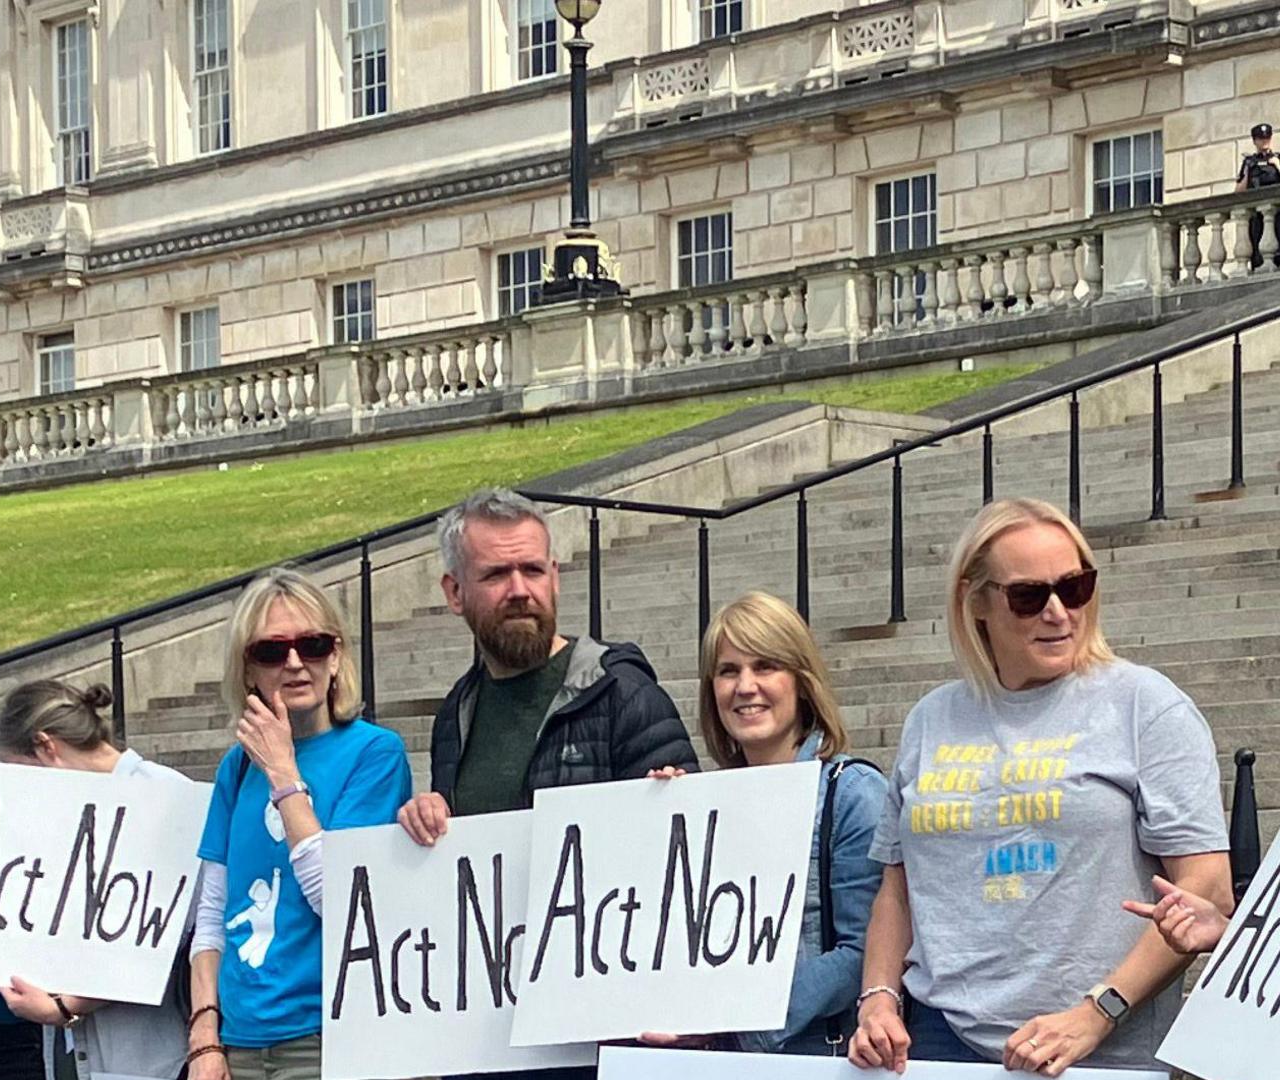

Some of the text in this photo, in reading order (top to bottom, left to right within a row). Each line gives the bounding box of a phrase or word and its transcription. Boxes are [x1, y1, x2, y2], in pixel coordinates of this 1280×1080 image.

[49, 804, 187, 948] Now
[911, 788, 1063, 833] REBEL EXIST
[331, 866, 441, 1020] Act
[530, 809, 795, 982] Act Now
